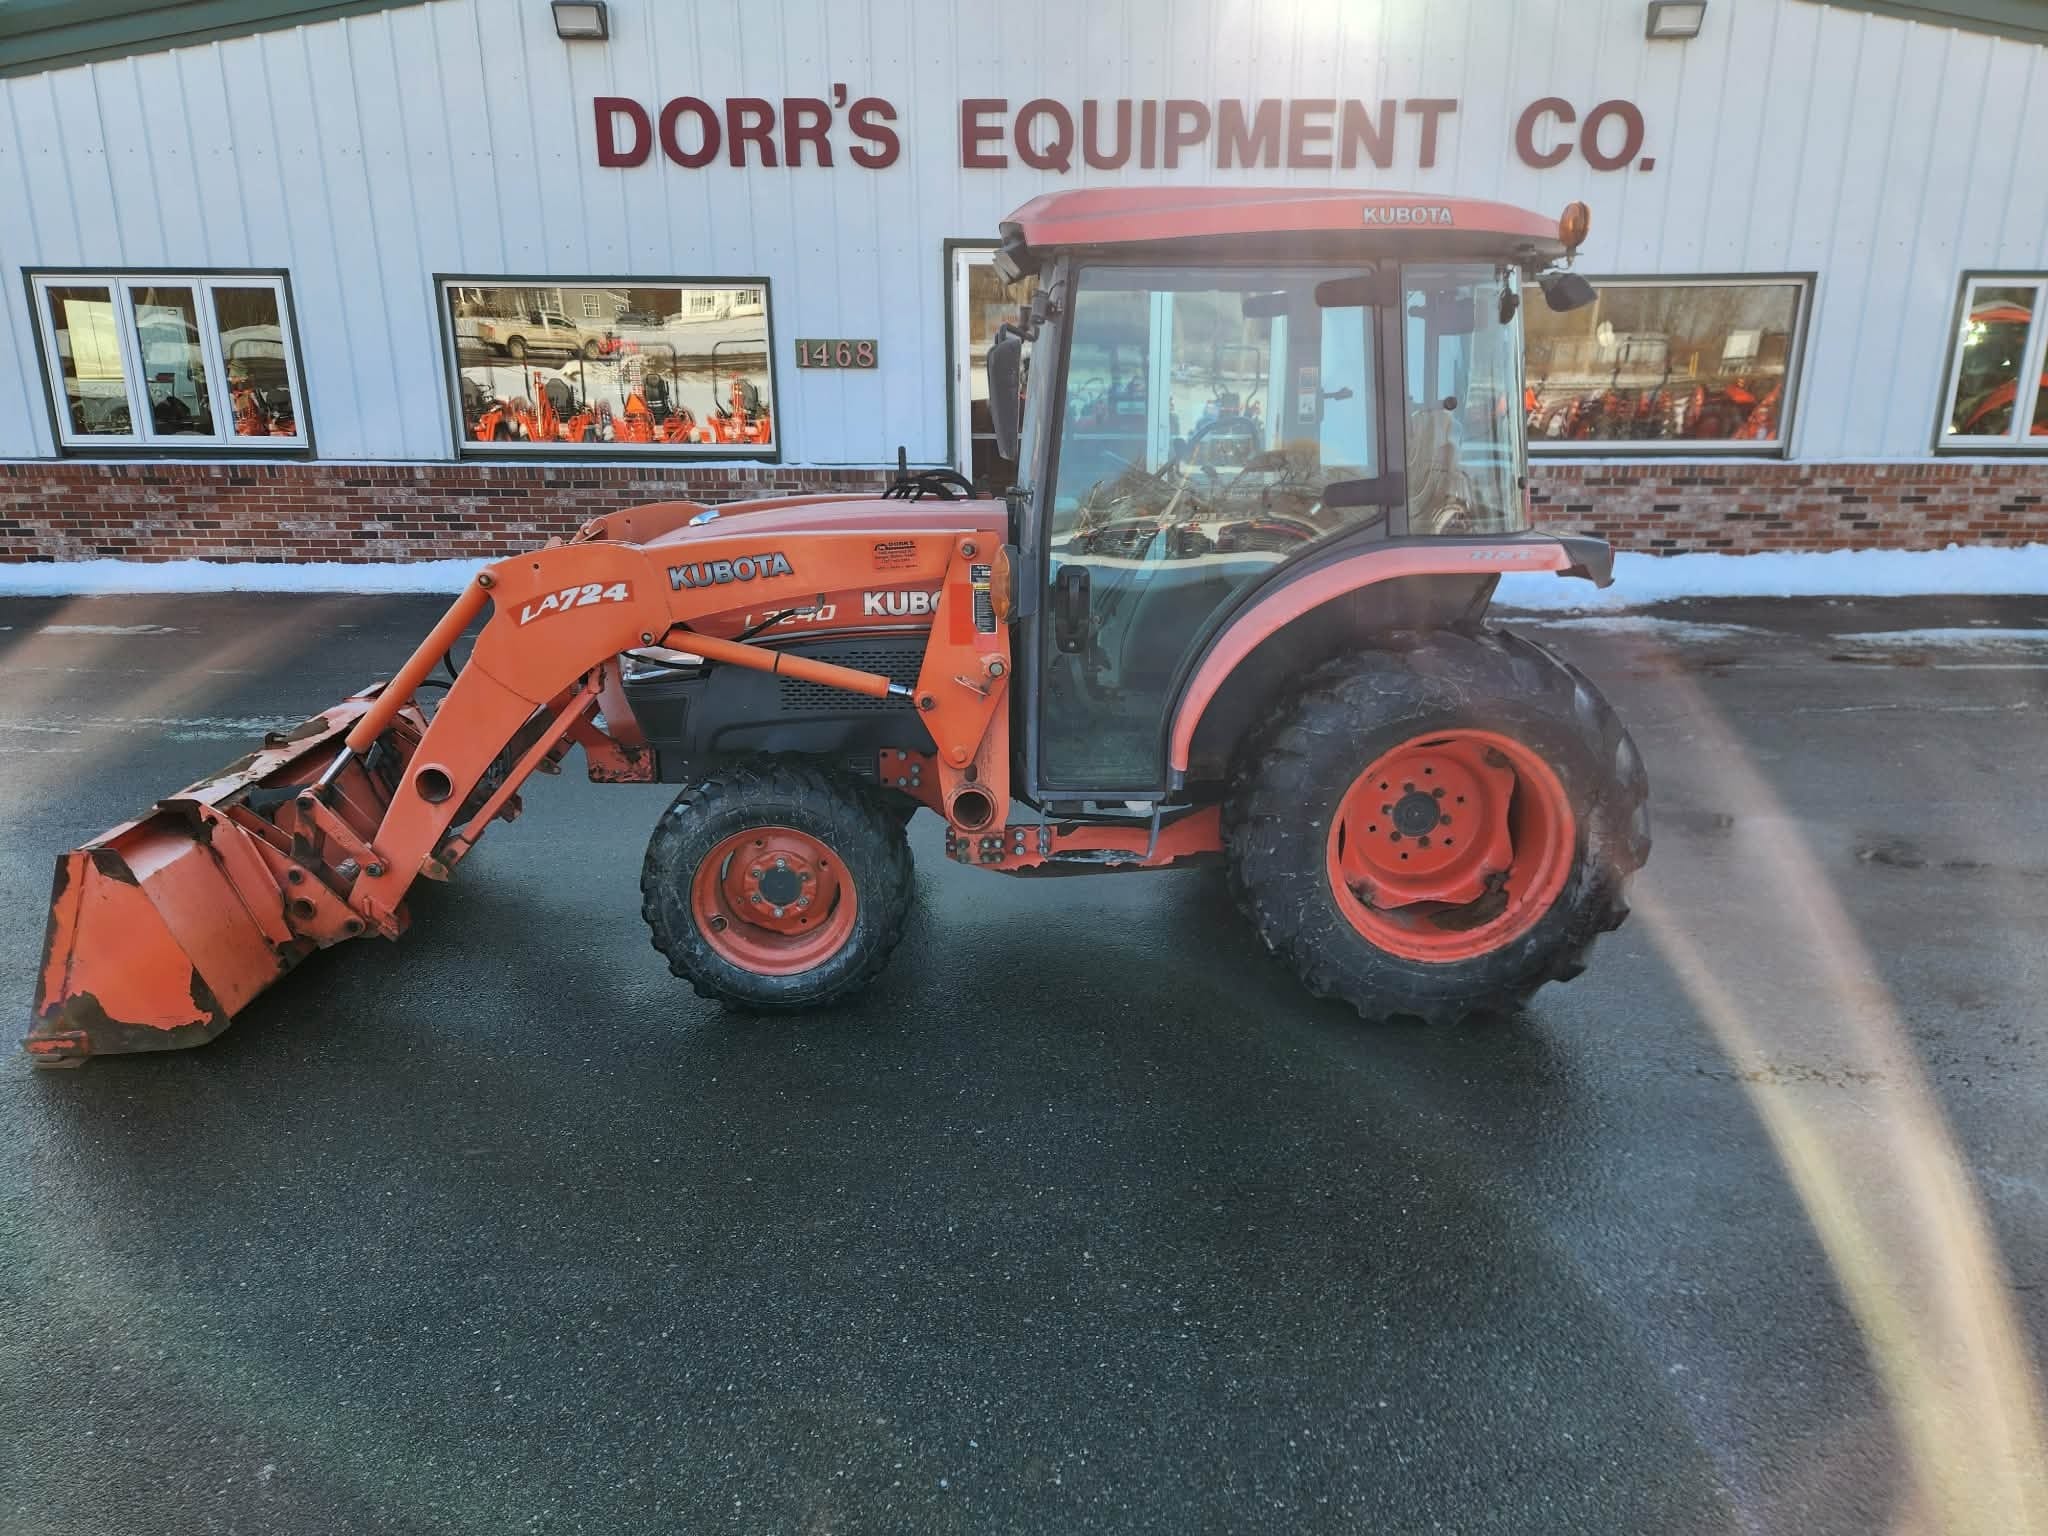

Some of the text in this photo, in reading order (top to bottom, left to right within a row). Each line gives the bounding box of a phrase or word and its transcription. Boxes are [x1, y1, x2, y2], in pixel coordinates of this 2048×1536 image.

[593, 83, 1656, 175] DORR'S EQUIPMENT CO.
[1362, 206, 1454, 225] KUBOTA
[799, 340, 876, 368] 1468
[667, 551, 794, 591] KUBOTA
[519, 582, 629, 626] LA724
